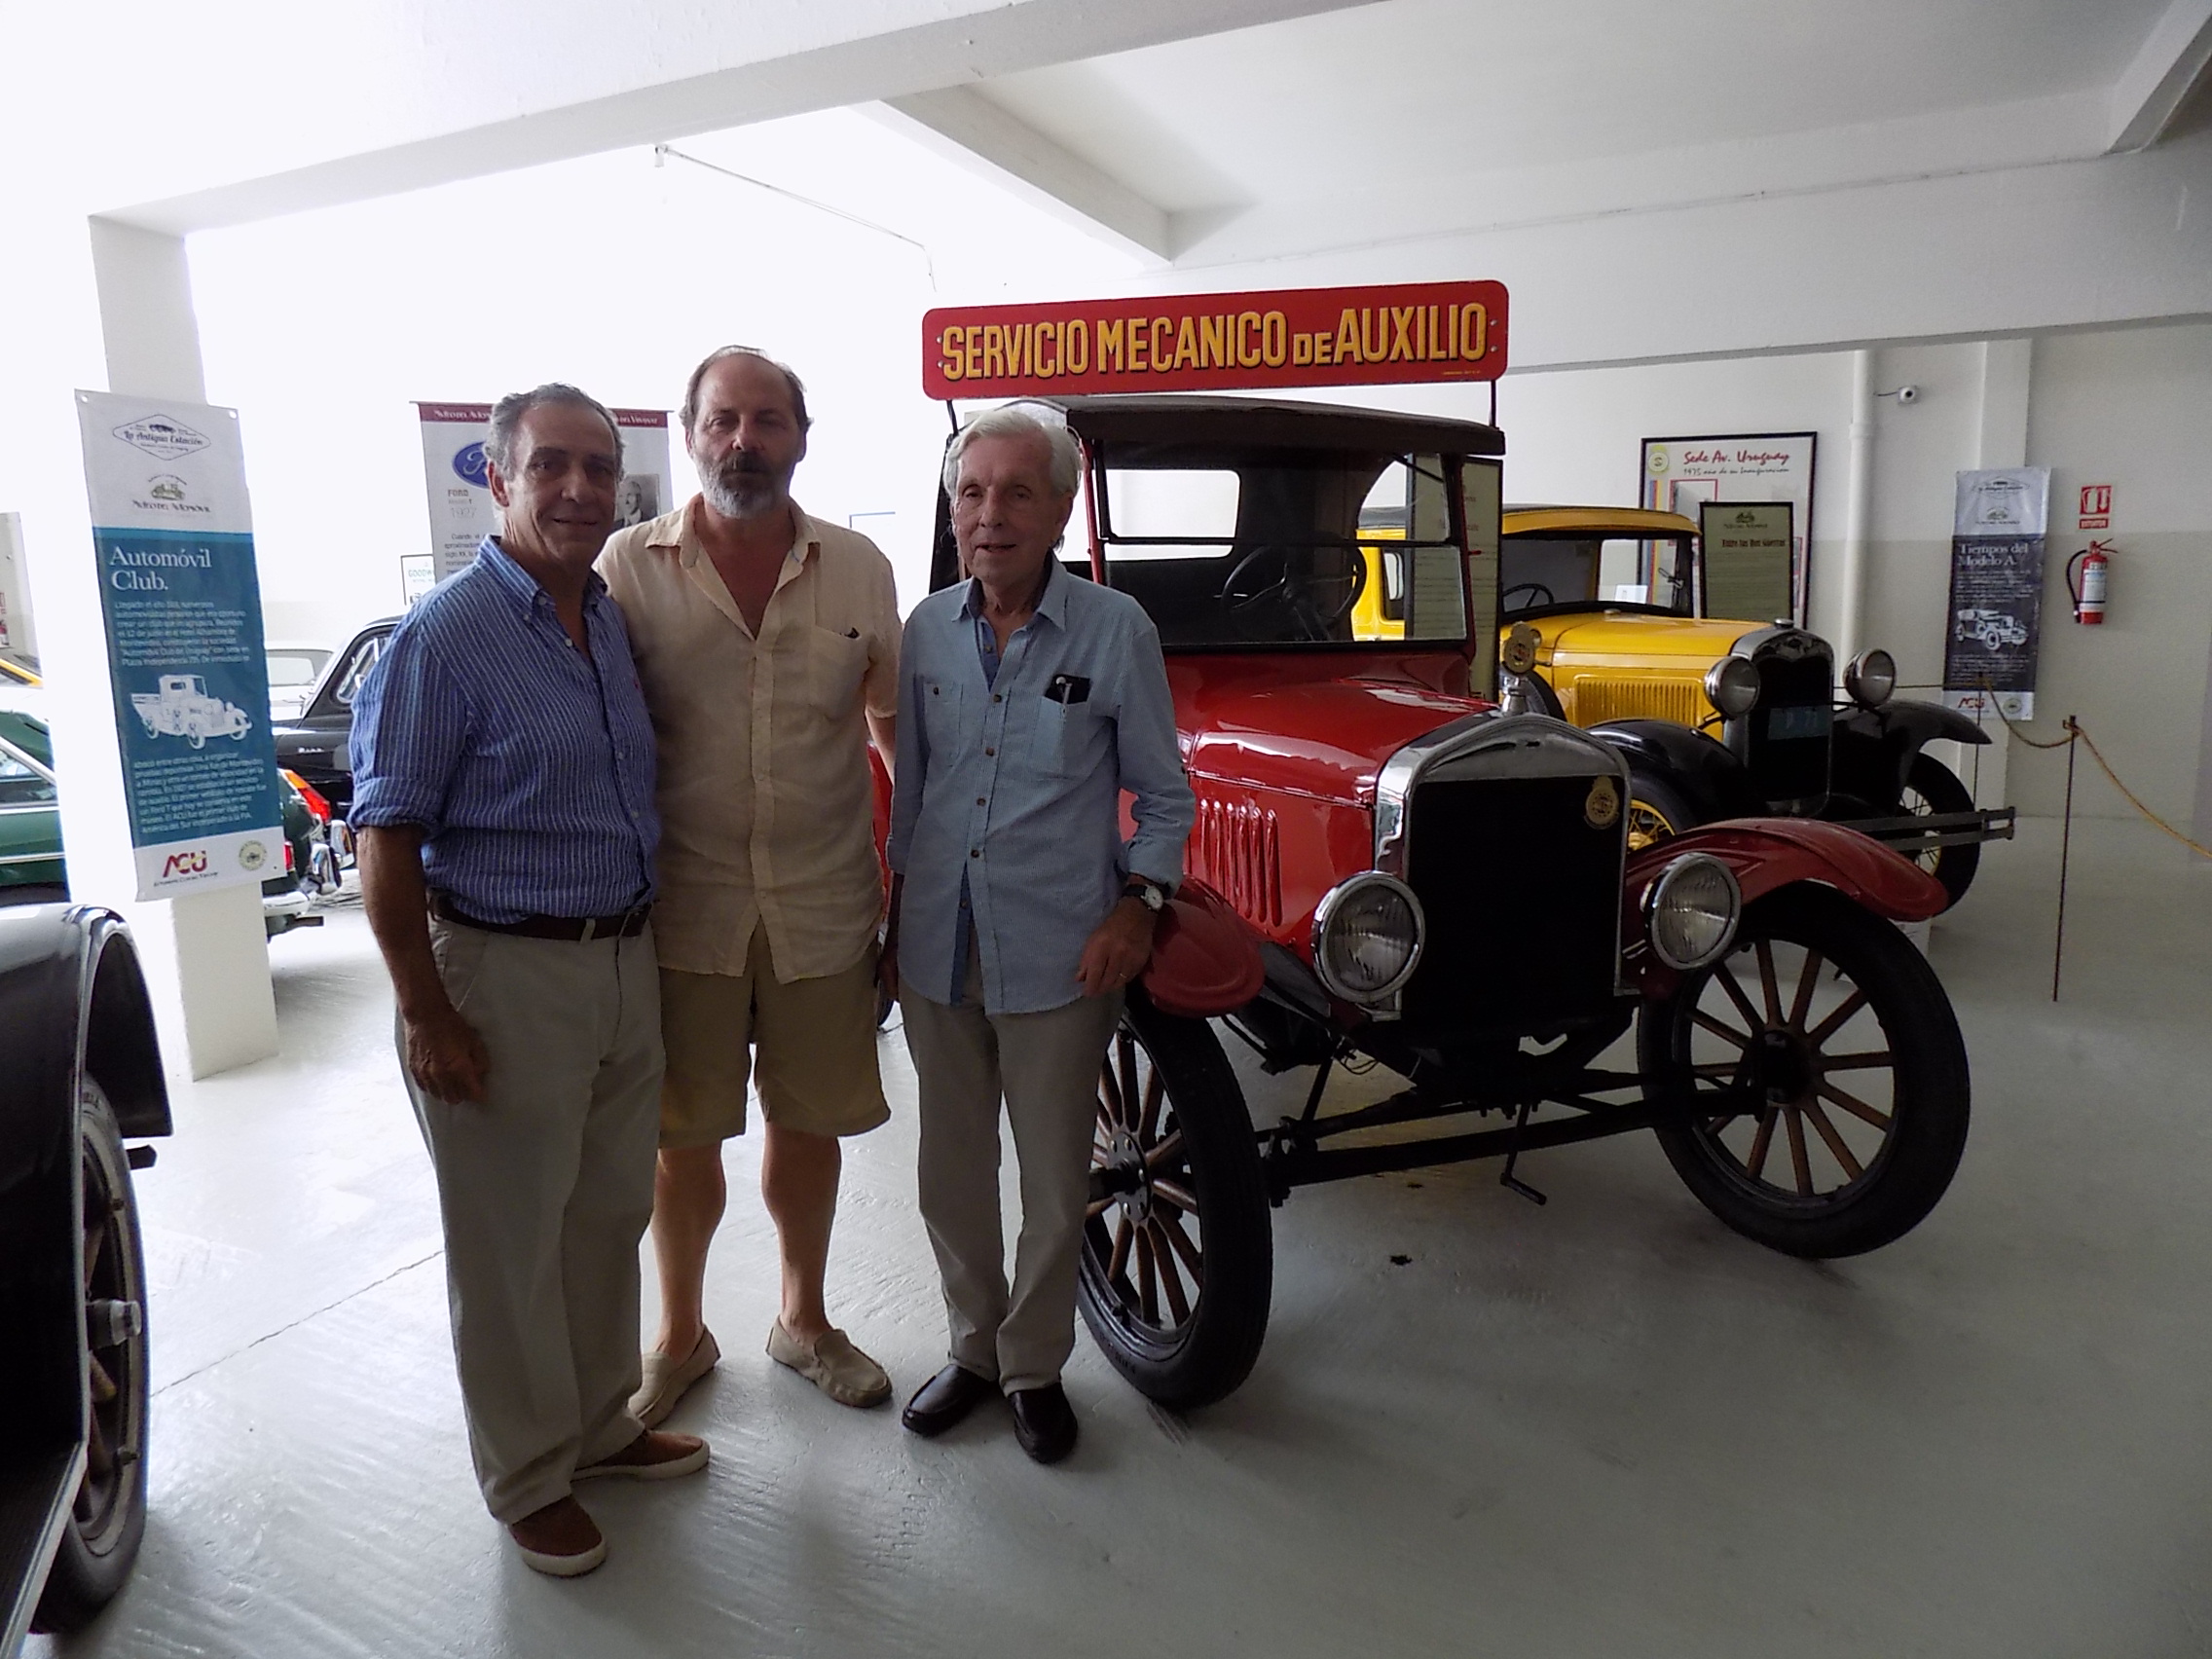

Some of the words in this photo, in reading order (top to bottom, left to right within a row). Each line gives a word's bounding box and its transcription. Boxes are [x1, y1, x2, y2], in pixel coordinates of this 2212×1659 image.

[942, 319, 1089, 381] SERVICIO
[1096, 311, 1287, 373] MECANICO
[1293, 332, 1332, 365] DE
[1334, 302, 1488, 365] AUXILIO
[1683, 450, 1709, 465] Sede
[1712, 450, 1731, 463] Av.
[1737, 449, 1789, 465] Uruguay
[448, 489, 469, 498] FORD
[110, 546, 212, 568] Automóvil
[1959, 543, 2008, 556] Tiempos
[2010, 542, 2028, 553] del
[1958, 555, 2002, 566] Modelo
[111, 570, 168, 591] Club.
[163, 850, 208, 877] ACU
